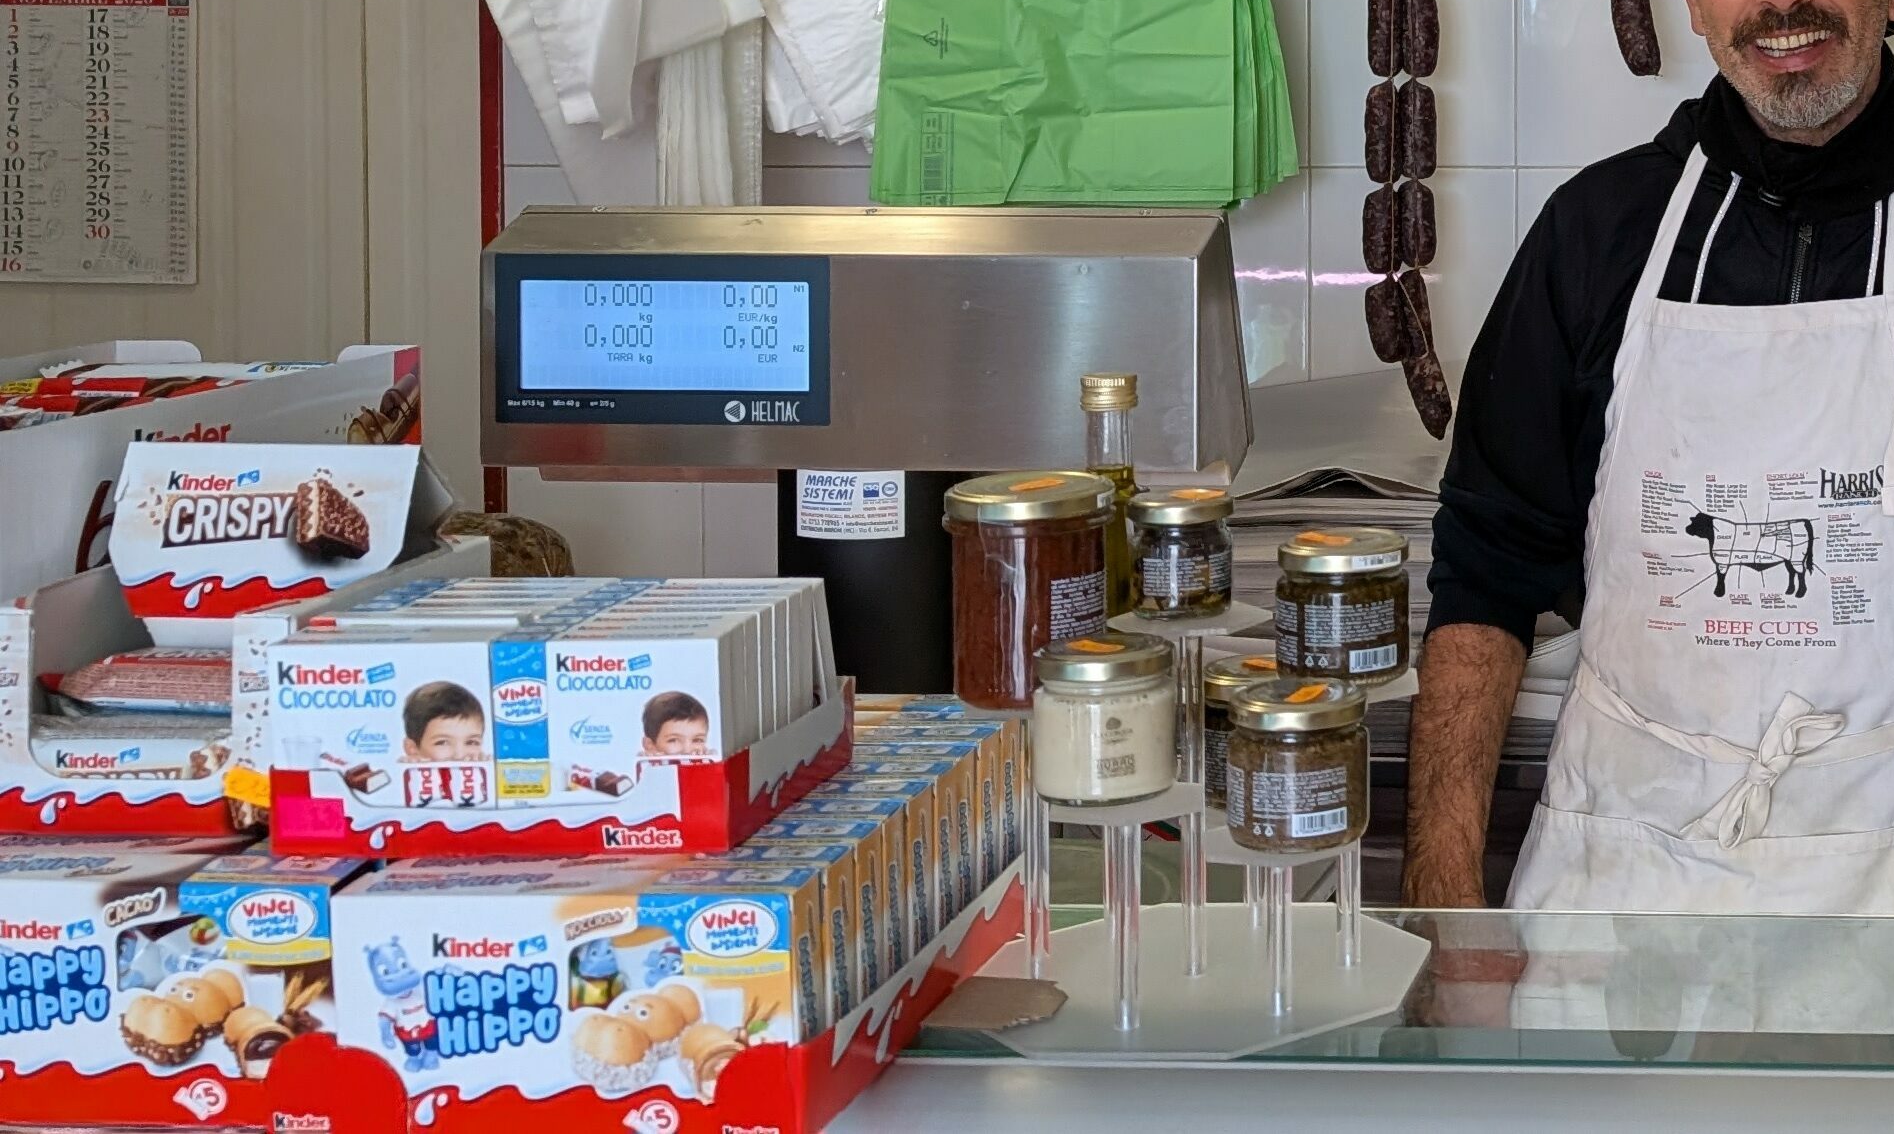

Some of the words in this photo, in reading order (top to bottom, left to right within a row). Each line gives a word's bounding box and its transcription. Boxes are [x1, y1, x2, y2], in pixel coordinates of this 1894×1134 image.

[9, 10, 17, 22] 1
[88, 10, 110, 22] 17
[7, 25, 19, 39] 2
[88, 26, 110, 39] 18
[7, 42, 19, 56] 3
[88, 43, 110, 56] 19
[7, 58, 19, 72] 4
[86, 59, 110, 73] 20
[7, 75, 19, 89] 5
[86, 76, 110, 89] 21
[7, 92, 19, 106] 6
[86, 92, 110, 106] 22
[7, 108, 19, 122] 7
[86, 109, 110, 123] 23
[7, 125, 19, 139] 8
[86, 126, 110, 139] 24
[7, 141, 19, 155] 9
[86, 142, 110, 156] 25
[2, 158, 24, 171] 10
[86, 159, 110, 172] 26
[2, 175, 24, 188] 11
[86, 176, 110, 189] 27
[2, 192, 24, 205] 12
[86, 192, 110, 206] 28
[2, 208, 24, 221] 13
[86, 209, 110, 222] 29
[2, 225, 24, 238] 14
[86, 226, 110, 239] 30
[2, 241, 24, 255] 15
[1, 259, 22, 272] 16
[585, 283, 653, 306] 0,000
[723, 284, 778, 307] 0,00
[639, 313, 653, 323] kg
[738, 313, 778, 324] EUR/kg
[585, 324, 653, 347] 0,000
[723, 326, 778, 348] 0,00
[607, 353, 633, 362] TARA
[639, 353, 653, 364] kg
[758, 354, 778, 363] EUR
[752, 401, 800, 422] HELMAC
[168, 471, 235, 492] Kinder
[806, 475, 857, 487] MARCHE
[803, 488, 854, 500] SISTEMI
[167, 496, 296, 543] CRISPY
[1705, 620, 1753, 634] BEEF
[1760, 622, 1818, 635] CUTS
[1695, 636, 1730, 646] Where
[1733, 637, 1763, 650] They
[1766, 638, 1801, 647] Come
[1804, 639, 1837, 647] From
[556, 654, 626, 672] Kinder
[277, 662, 363, 685] Kinder
[557, 674, 652, 691] CIOCCOLATO
[278, 687, 396, 709] CIOCCOLATO
[499, 686, 541, 700] VINCI
[56, 750, 118, 768] Kinder
[604, 828, 680, 847] Kinder
[107, 898, 154, 921] CACAO
[243, 899, 295, 917] VINCI
[703, 911, 755, 928] VINCI
[433, 934, 513, 957] Kinder
[425, 966, 556, 1014] Happy
[436, 1007, 559, 1055] Hippo
[275, 1115, 327, 1128] Kinder
